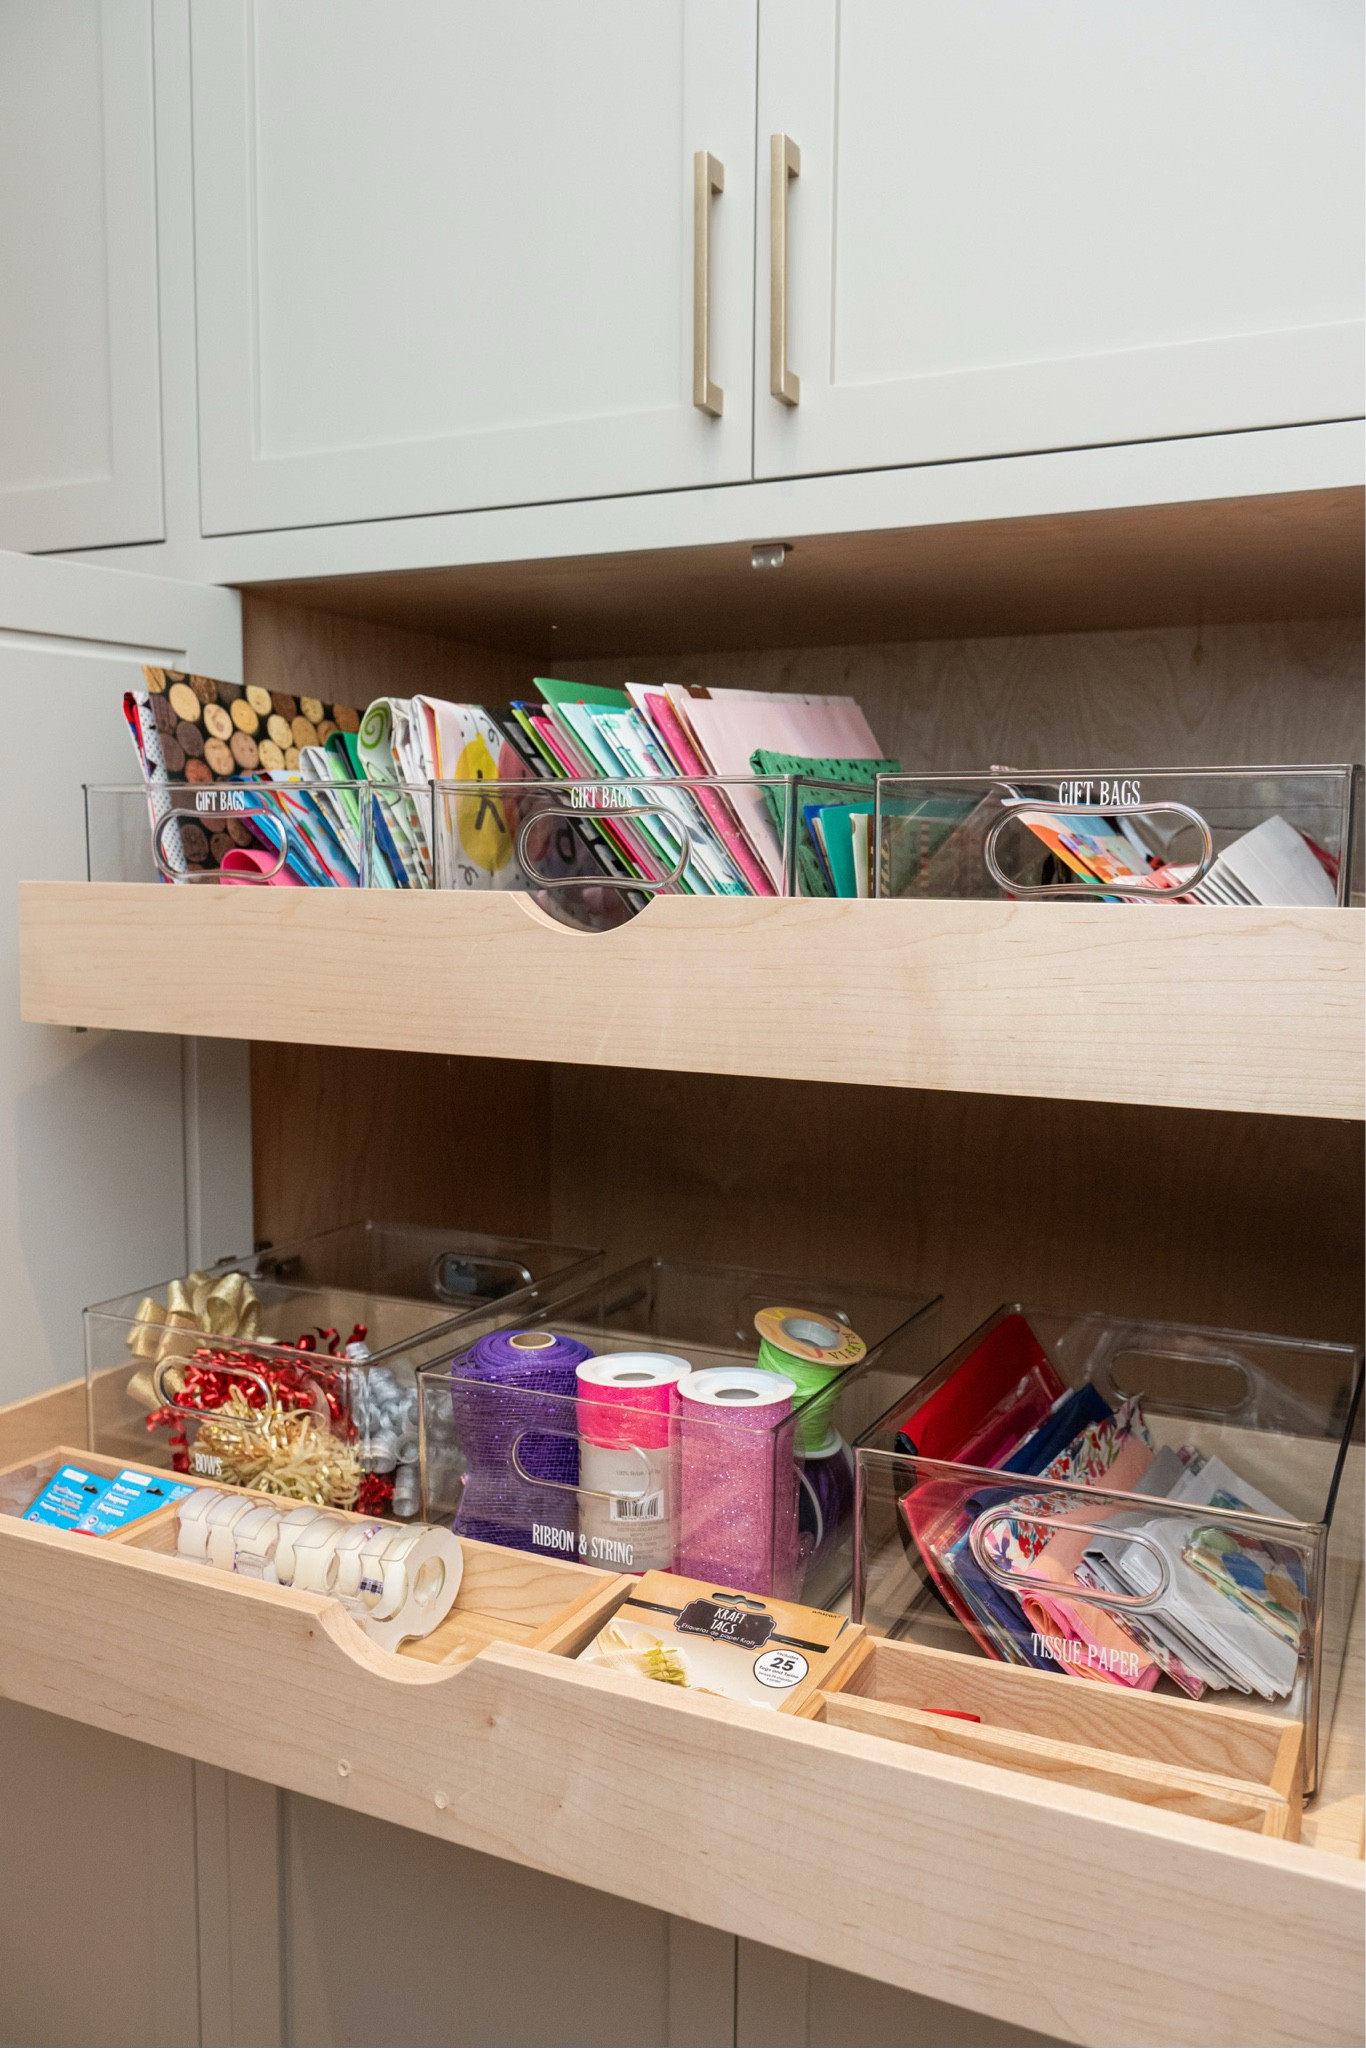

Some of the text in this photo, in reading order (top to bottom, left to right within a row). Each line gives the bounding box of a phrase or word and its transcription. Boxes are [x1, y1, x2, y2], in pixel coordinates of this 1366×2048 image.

[195, 790, 245, 811] GIFT BAGS
[571, 785, 632, 809] GIFT BAGS
[1059, 780, 1140, 806] GIFT BAGS
[195, 1453, 222, 1477] BOWS
[532, 1523, 574, 1553] RIBBON
[578, 1534, 588, 1556] &
[591, 1536, 634, 1566] STRING
[714, 1607, 747, 1624] KRAFT
[681, 1622, 709, 1634] Etiquetas
[719, 1633, 740, 1642] papel
[710, 1619, 737, 1635] TAGS
[770, 1657, 796, 1671] 25
[1031, 1632, 1139, 1677] TISSUE PAPER
